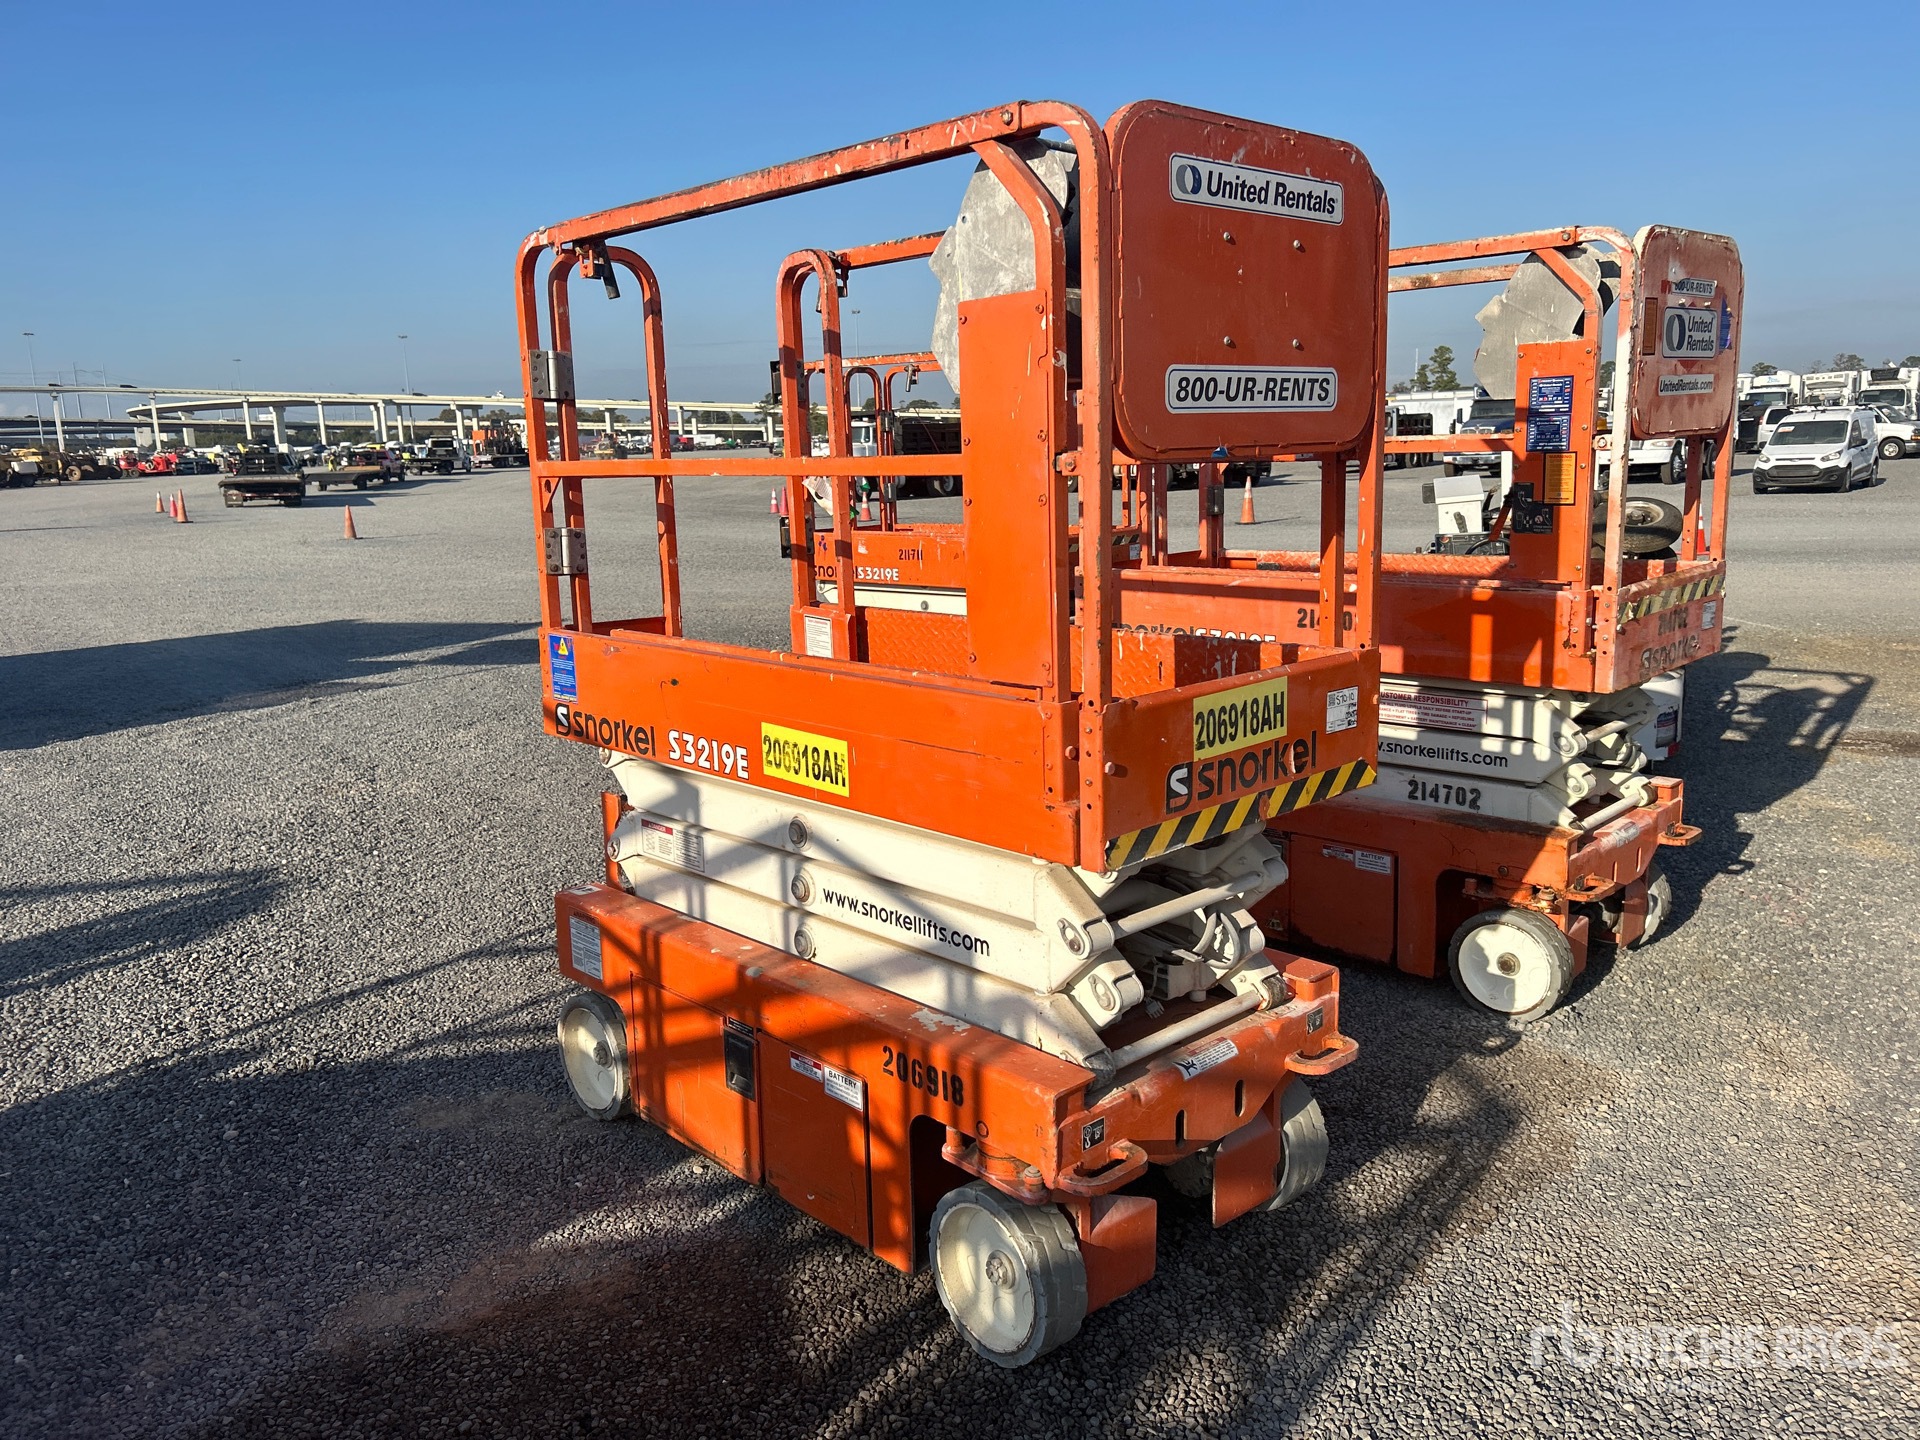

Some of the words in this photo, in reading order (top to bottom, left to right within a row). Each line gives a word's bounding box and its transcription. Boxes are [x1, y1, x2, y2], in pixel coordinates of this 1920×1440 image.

[1206, 170, 1270, 205] United
[1274, 182, 1336, 215] Rentals
[1687, 316, 1714, 333] United
[1686, 335, 1715, 351] Rentals
[1175, 376, 1331, 402] 800-UR-RENTS
[1659, 377, 1713, 393] UnitedRentals.com
[857, 566, 899, 581] S3219E
[1380, 691, 1412, 701] USTOMER
[1413, 694, 1469, 707] RESPONSIBILITY
[1194, 691, 1285, 751] 206918AH
[571, 711, 657, 757] snorkel
[667, 729, 750, 780] S3219E
[762, 734, 846, 787] 206918AH
[1196, 730, 1318, 801] snorkel
[1408, 779, 1481, 811] 214702
[1360, 852, 1385, 861] BATTERY
[822, 888, 991, 957] www.snorkellifts.com
[828, 1070, 857, 1089] BATTERY
[882, 1045, 964, 1107] 206918
